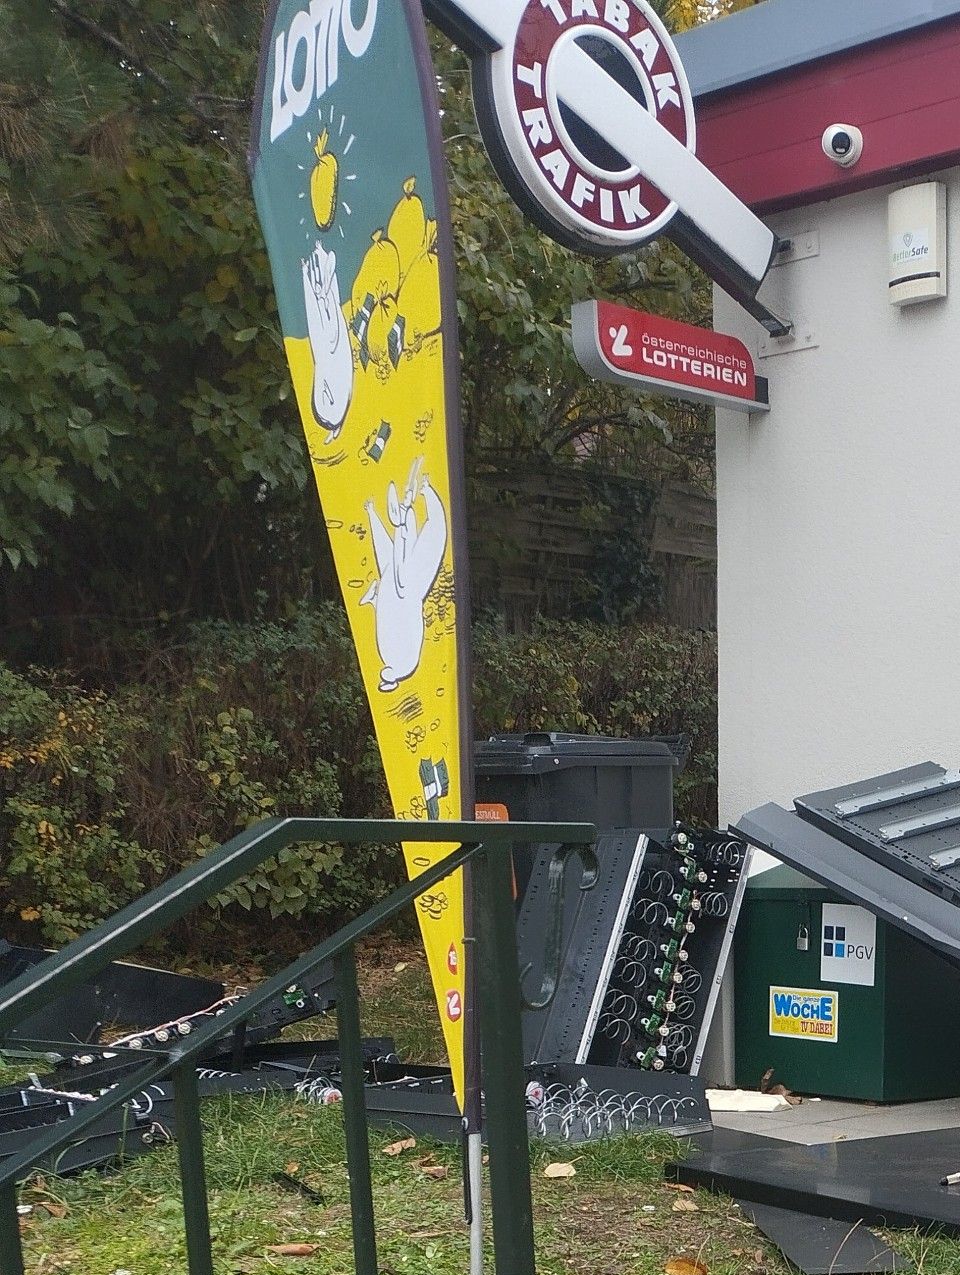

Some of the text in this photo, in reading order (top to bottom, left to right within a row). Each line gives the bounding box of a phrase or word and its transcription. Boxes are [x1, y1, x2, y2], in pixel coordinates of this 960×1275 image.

[271, 0, 378, 143] LOTTO
[516, 62, 651, 224] TRAFIK
[641, 332, 747, 369] österreichische
[642, 347, 747, 387] LOTTERIEN
[475, 810, 500, 820] ESTMÜLL
[847, 944, 873, 960] PGV
[774, 994, 832, 1020] WOCHE
[801, 1021, 809, 1033] TV
[810, 1022, 832, 1035] DABEI
